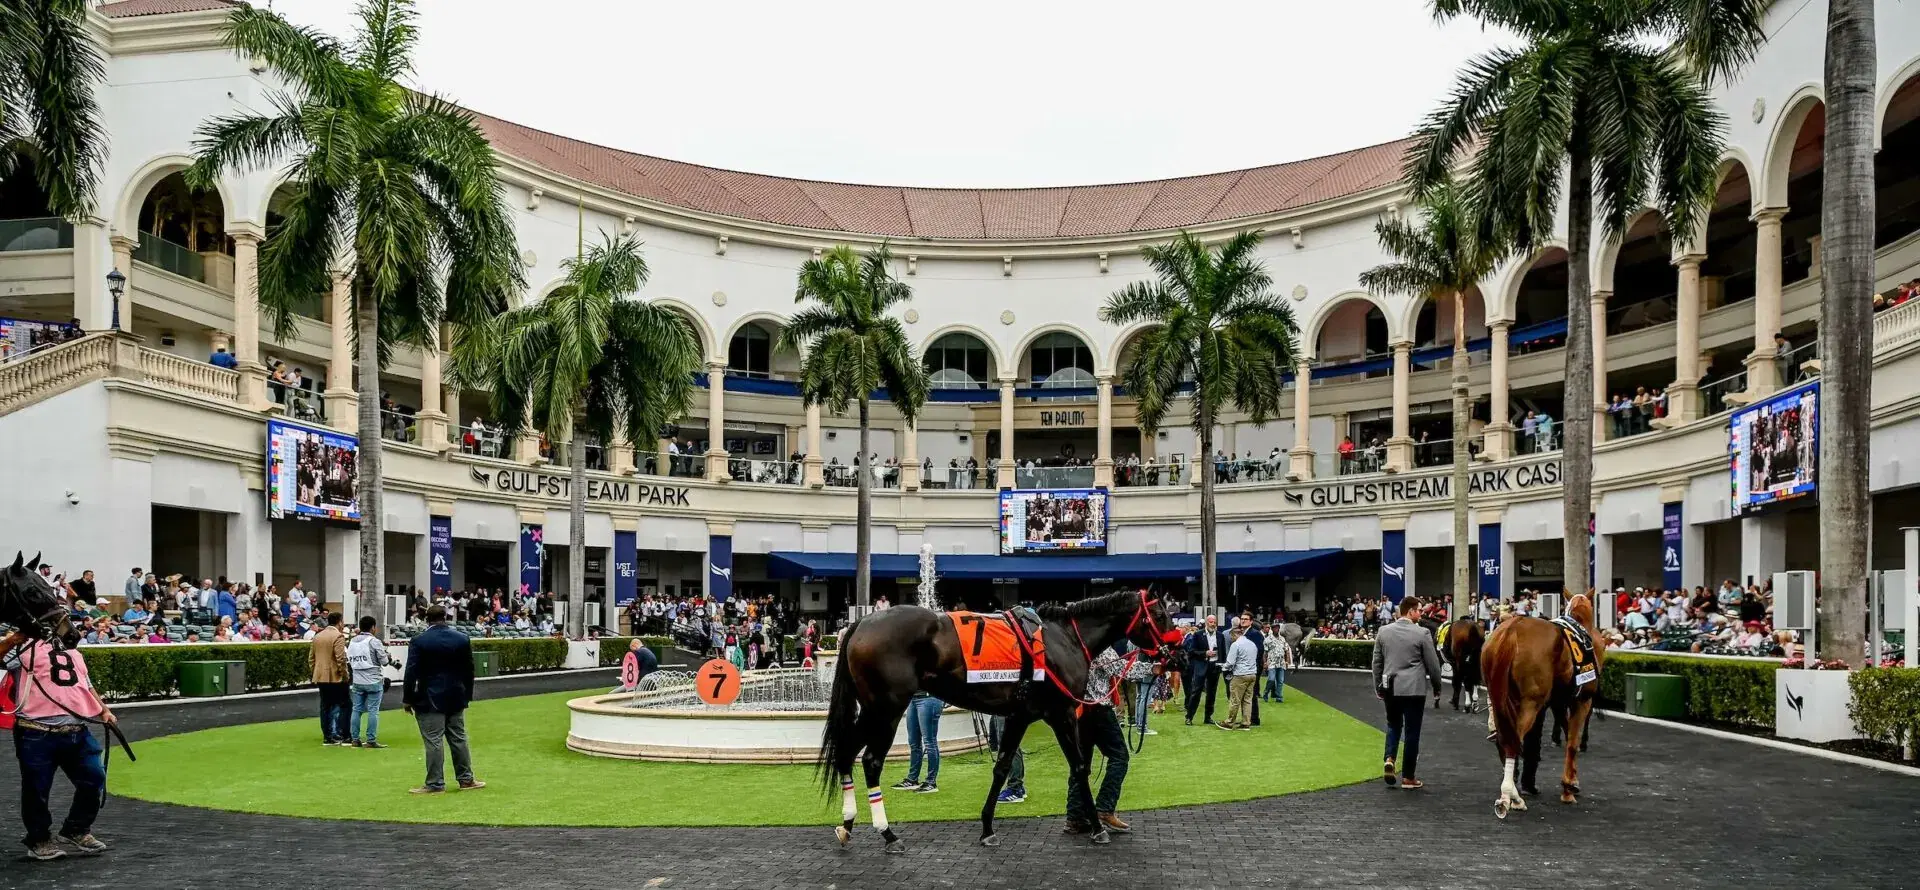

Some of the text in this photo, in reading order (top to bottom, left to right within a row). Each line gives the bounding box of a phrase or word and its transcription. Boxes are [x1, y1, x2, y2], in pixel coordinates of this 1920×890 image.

[1040, 410, 1085, 426] TEN PALMS
[496, 470, 690, 506] GULFSTEAM PARK
[1310, 460, 1563, 507] GULFSTREAM ARK CASI
[621, 569, 636, 577] BET
[1484, 566, 1500, 575] BET
[960, 615, 986, 656] 7
[1564, 628, 1583, 663] 6
[48, 650, 79, 687] 8
[627, 663, 634, 683] 8
[709, 673, 727, 699] 7
